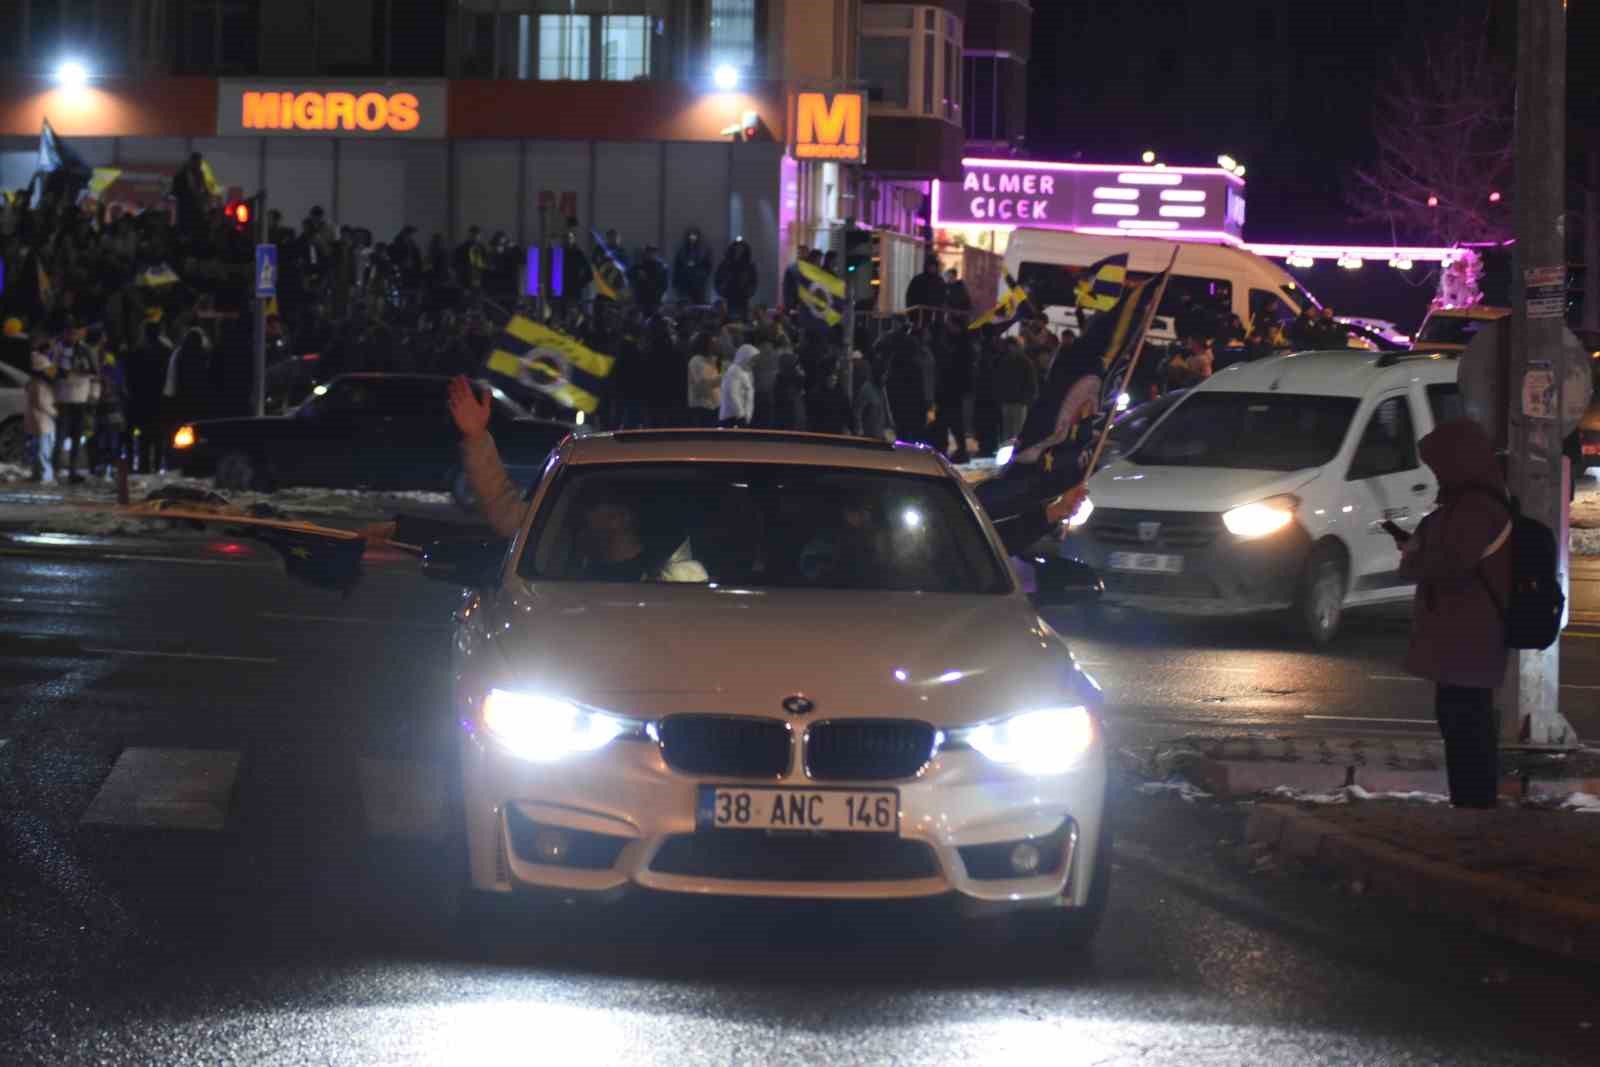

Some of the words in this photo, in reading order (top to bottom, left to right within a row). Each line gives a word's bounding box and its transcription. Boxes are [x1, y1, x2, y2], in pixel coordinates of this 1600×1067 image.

[797, 92, 862, 144] M
[963, 171, 1055, 195] ALMER
[716, 791, 751, 824] 38
[769, 793, 824, 826] ANC
[844, 796, 891, 828] 146
